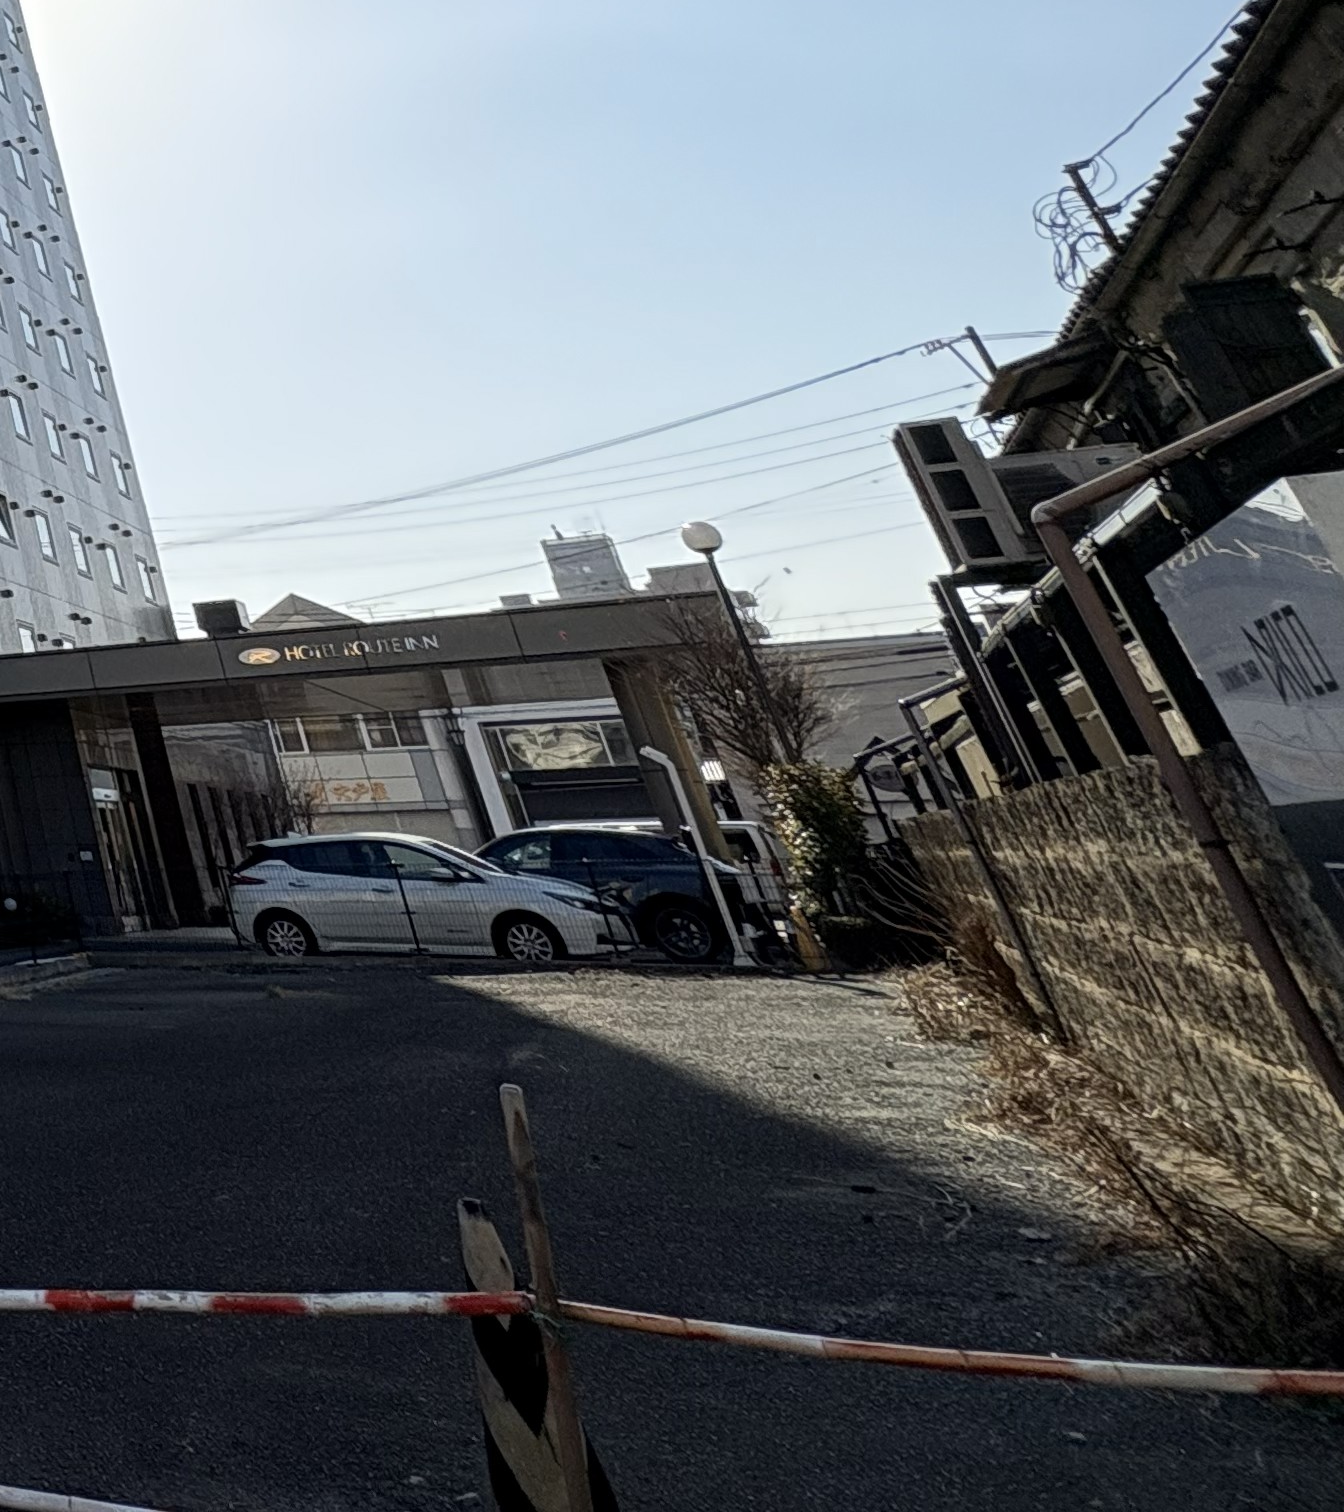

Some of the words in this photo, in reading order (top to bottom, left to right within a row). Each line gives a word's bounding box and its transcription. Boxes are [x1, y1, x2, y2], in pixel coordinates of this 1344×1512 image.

[285, 644, 341, 662] HOTEL
[344, 638, 402, 656] ROUTE
[405, 635, 439, 650] INN
